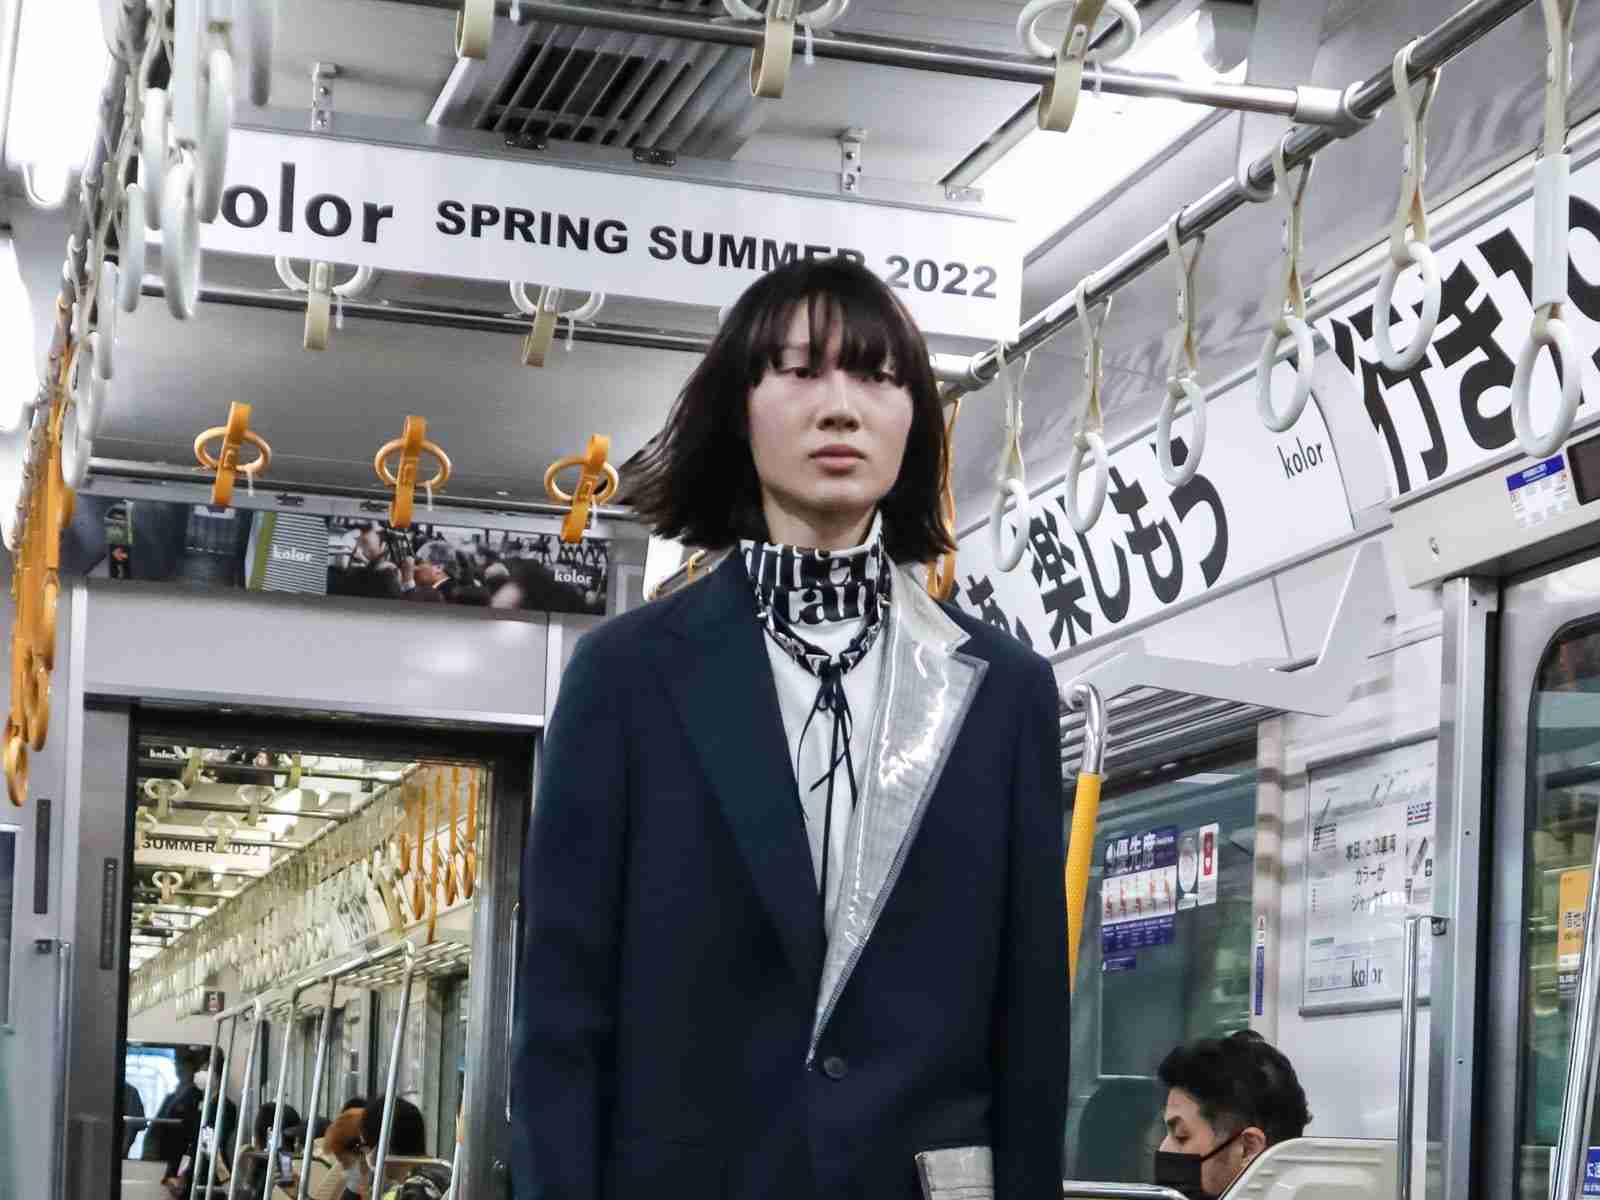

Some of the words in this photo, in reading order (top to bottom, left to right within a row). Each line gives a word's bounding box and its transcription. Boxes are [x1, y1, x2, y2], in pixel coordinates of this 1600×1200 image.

[221, 162, 394, 244] olor
[436, 200, 629, 254] SPRING
[885, 255, 997, 299] 2022
[1277, 436, 1323, 479] kolor
[272, 543, 313, 563] kolor
[554, 569, 593, 585] kolor
[1351, 960, 1384, 988] kolor
